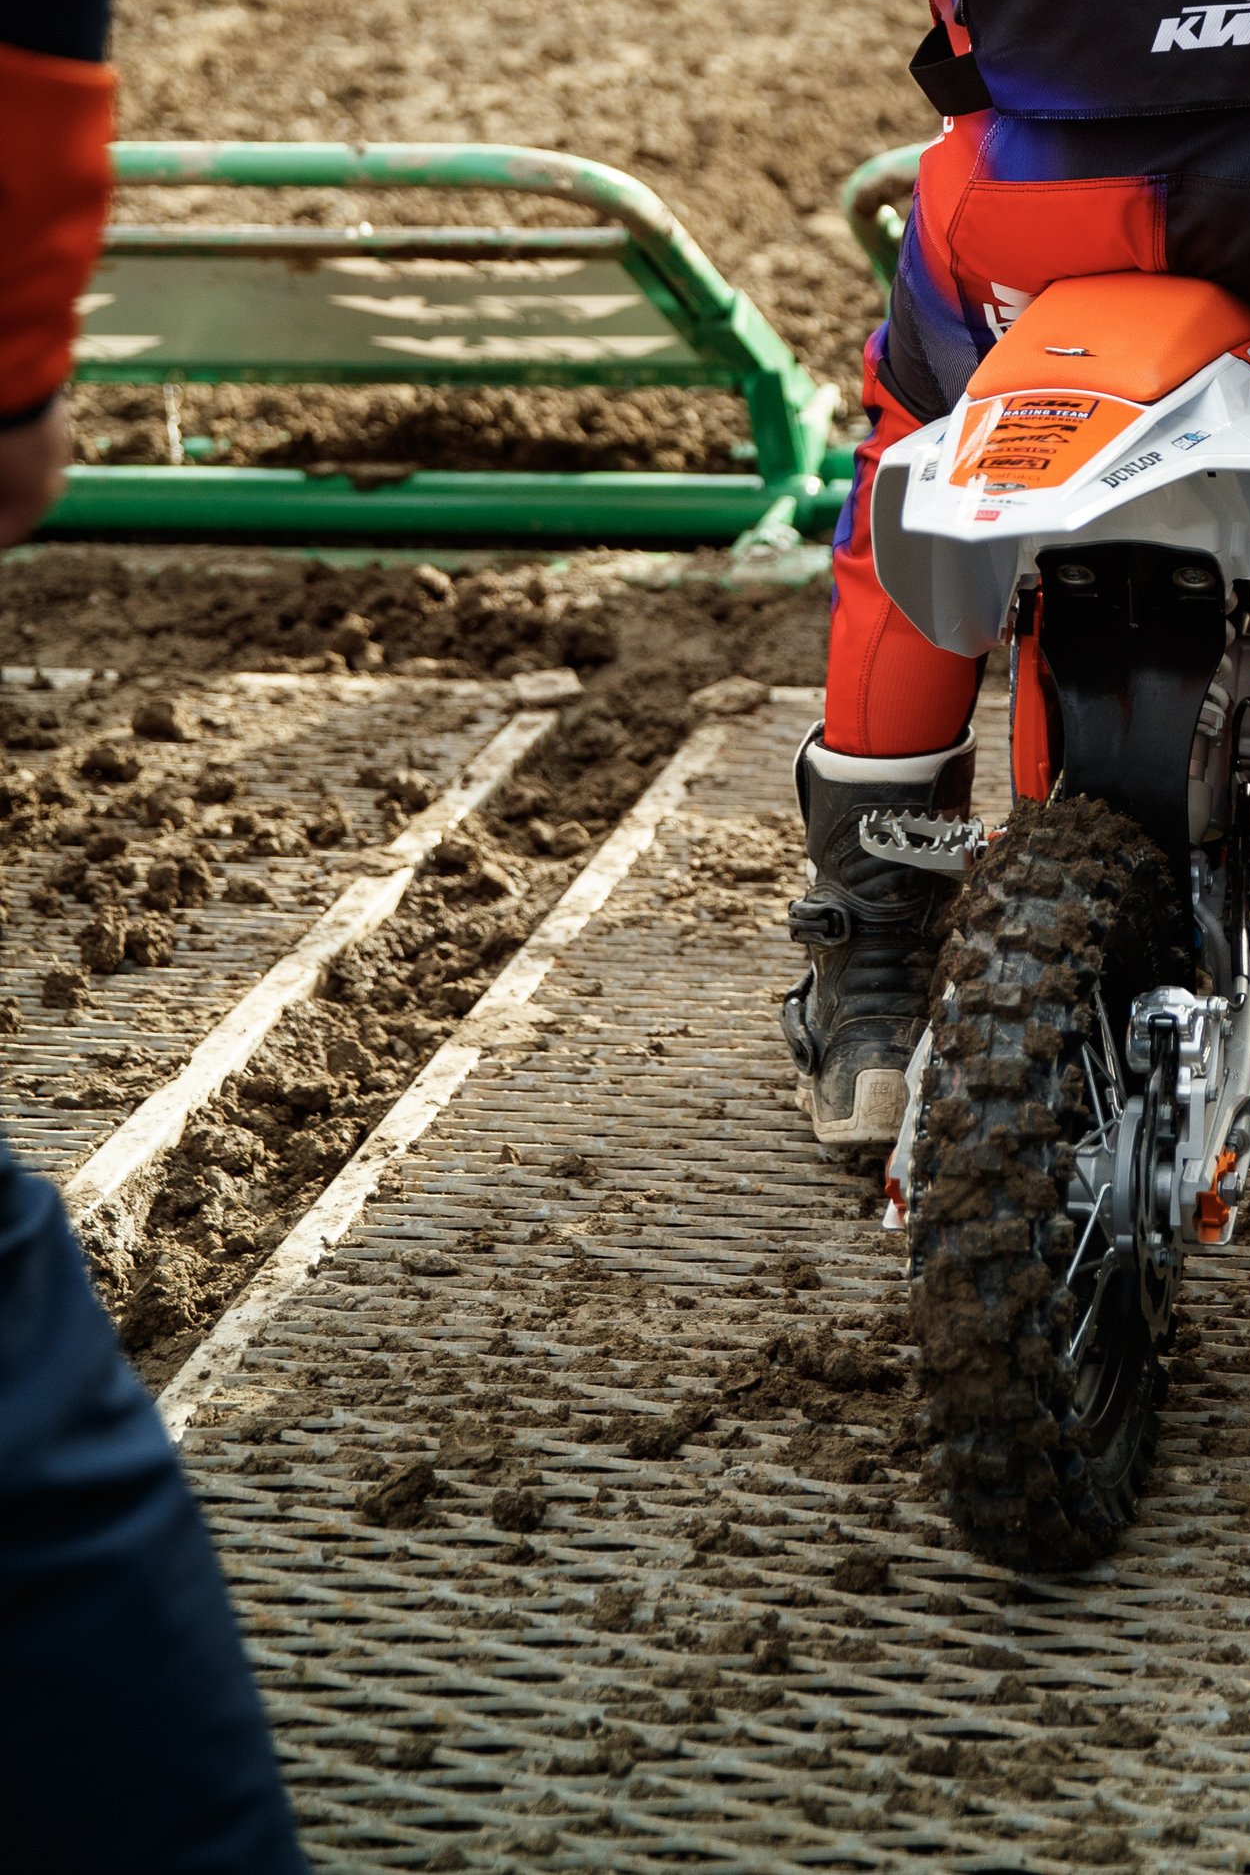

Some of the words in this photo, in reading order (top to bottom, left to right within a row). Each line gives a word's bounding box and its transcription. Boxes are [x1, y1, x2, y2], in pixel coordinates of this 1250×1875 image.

[1003, 409, 1051, 417] RACING
[1055, 410, 1089, 418] TEAM
[1018, 416, 1084, 424] SUPERCROSS
[1101, 451, 1163, 489] DUNLOP
